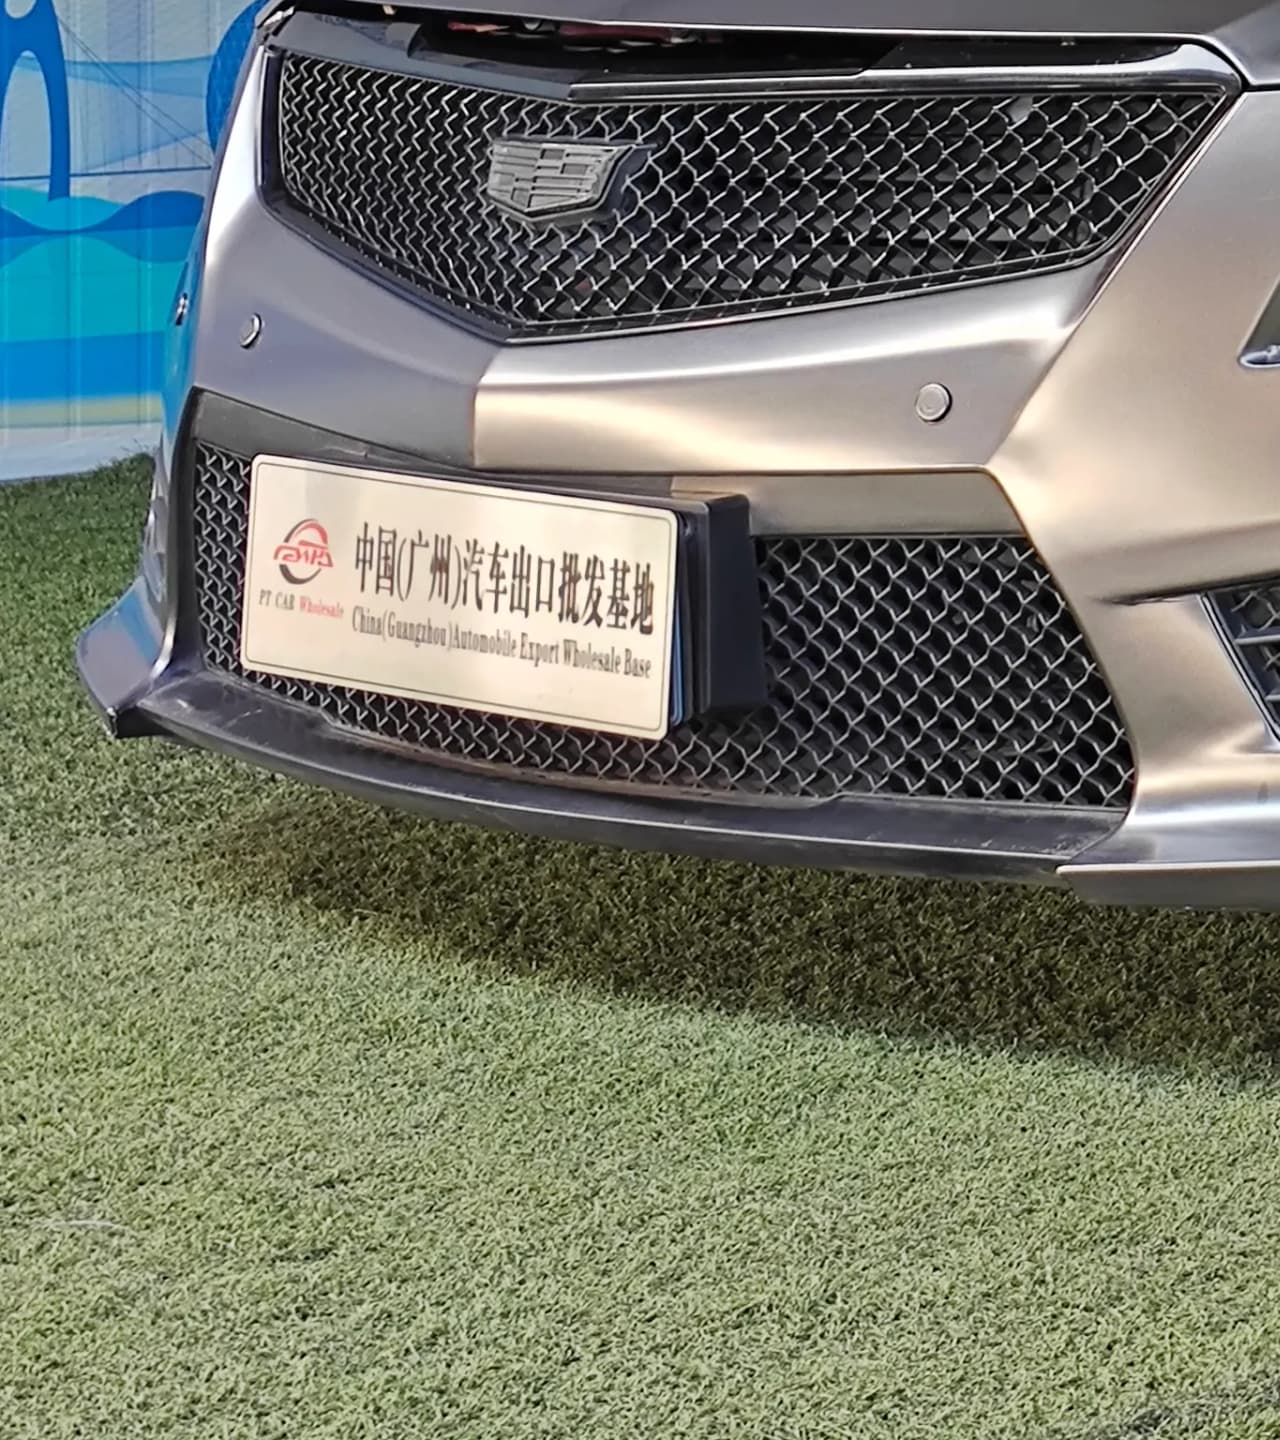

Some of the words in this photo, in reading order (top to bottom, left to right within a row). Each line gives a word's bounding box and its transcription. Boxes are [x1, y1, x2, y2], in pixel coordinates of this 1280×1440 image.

[353, 521, 656, 636] 中国(广州)汽车出口批发基地
[519, 631, 560, 668] Export
[562, 638, 622, 677] Wholesale
[623, 647, 652, 679] Base
